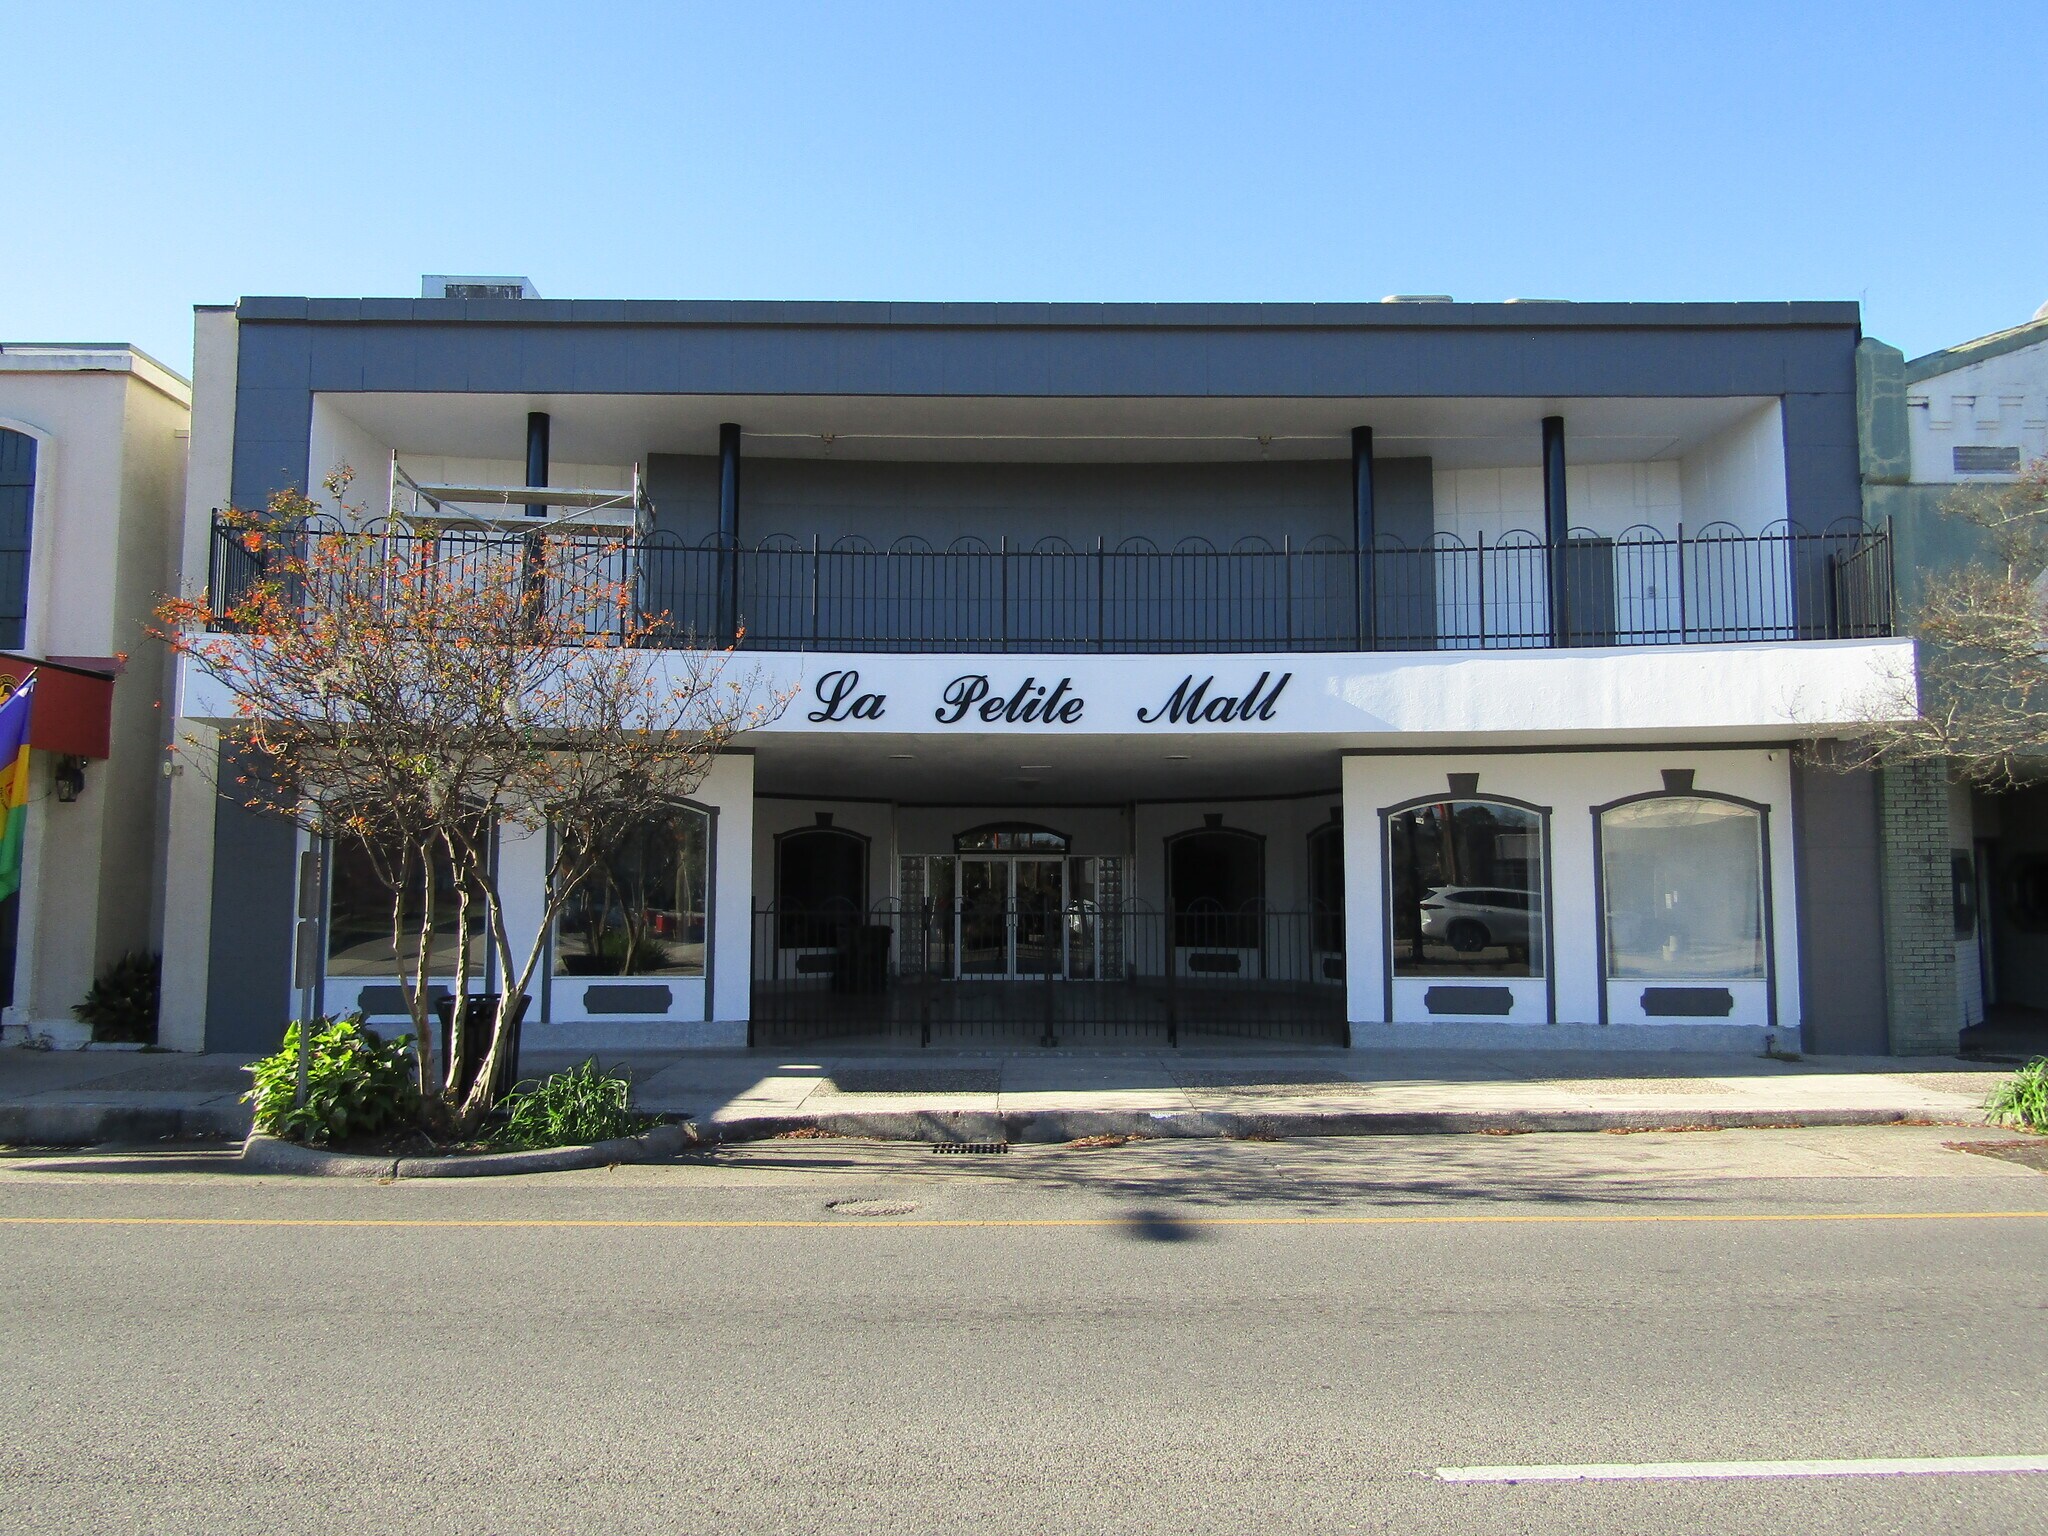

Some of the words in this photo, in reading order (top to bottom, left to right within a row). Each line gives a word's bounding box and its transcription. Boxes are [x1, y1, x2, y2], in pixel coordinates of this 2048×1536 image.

[808, 671, 886, 722] La
[935, 675, 1084, 724] Petite
[1137, 672, 1292, 724] Mall
